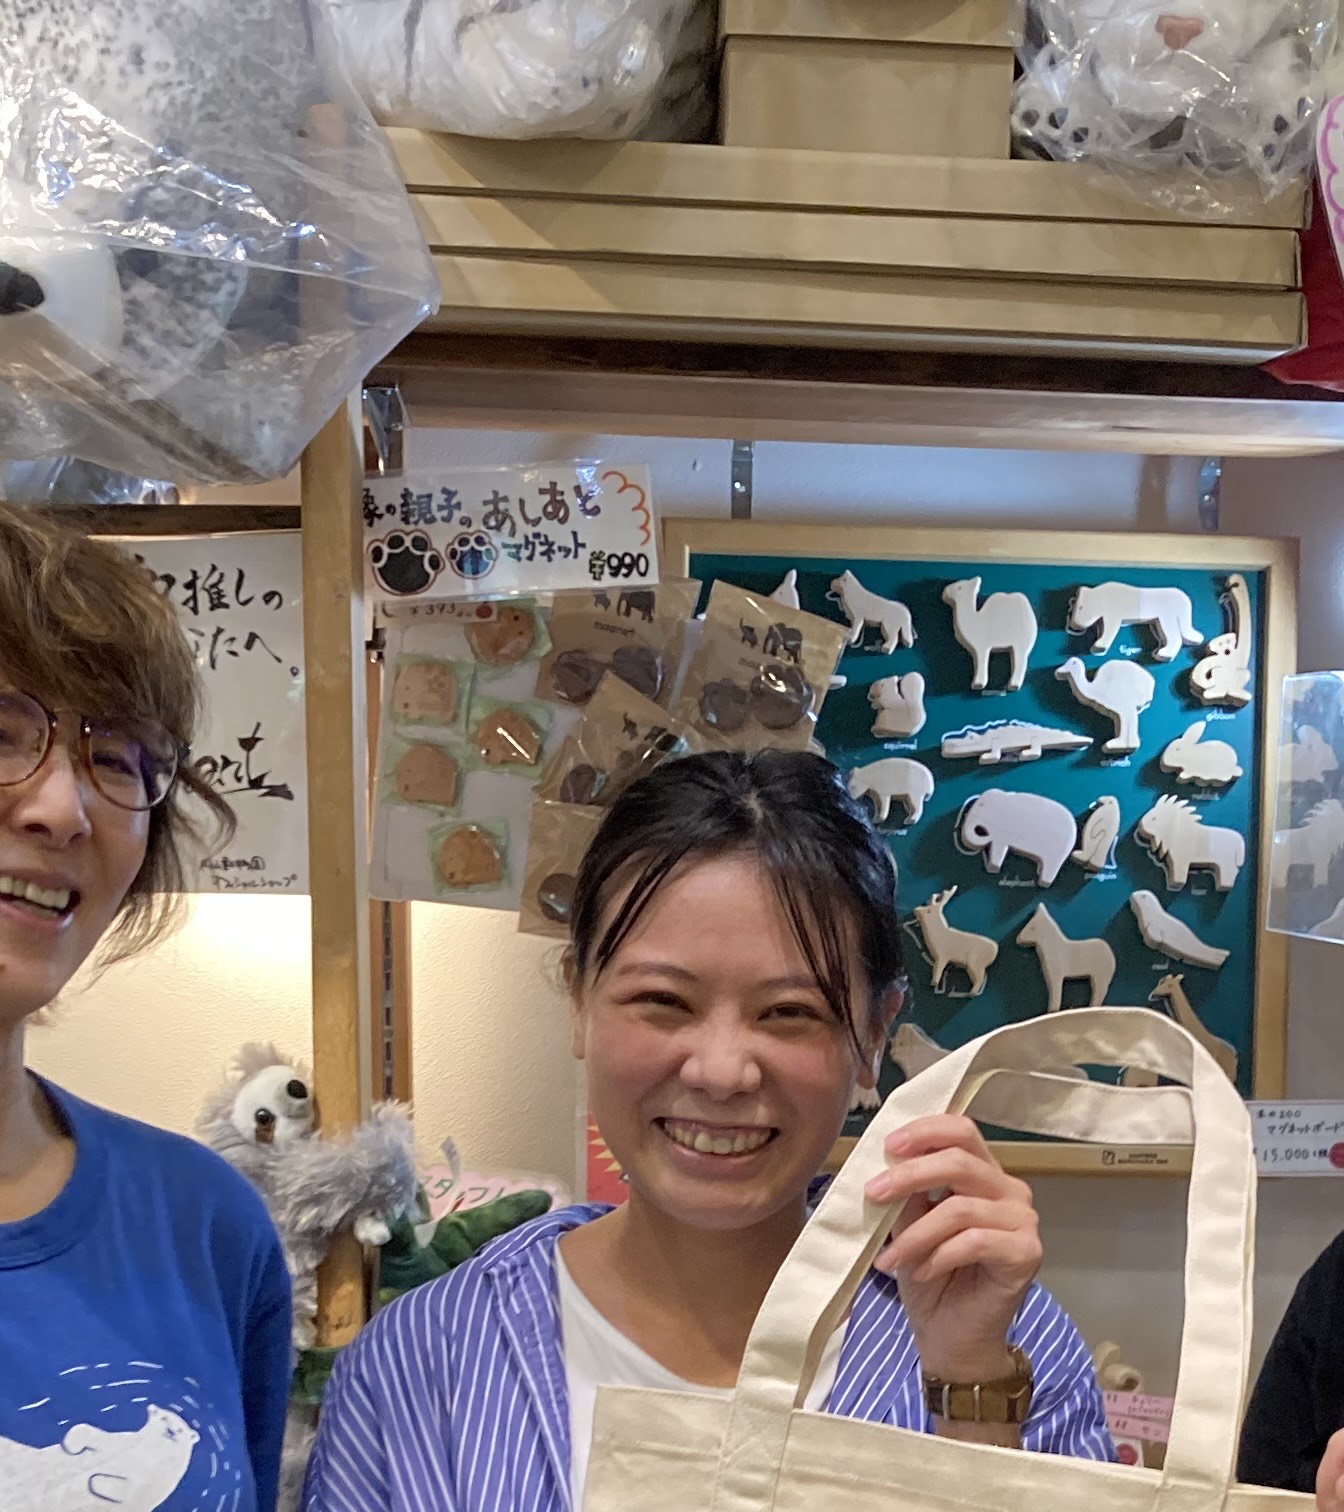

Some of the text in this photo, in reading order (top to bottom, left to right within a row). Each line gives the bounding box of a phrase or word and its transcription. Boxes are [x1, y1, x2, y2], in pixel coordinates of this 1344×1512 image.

[501, 530, 586, 563] マグネット
[589, 551, 649, 581] ¥990
